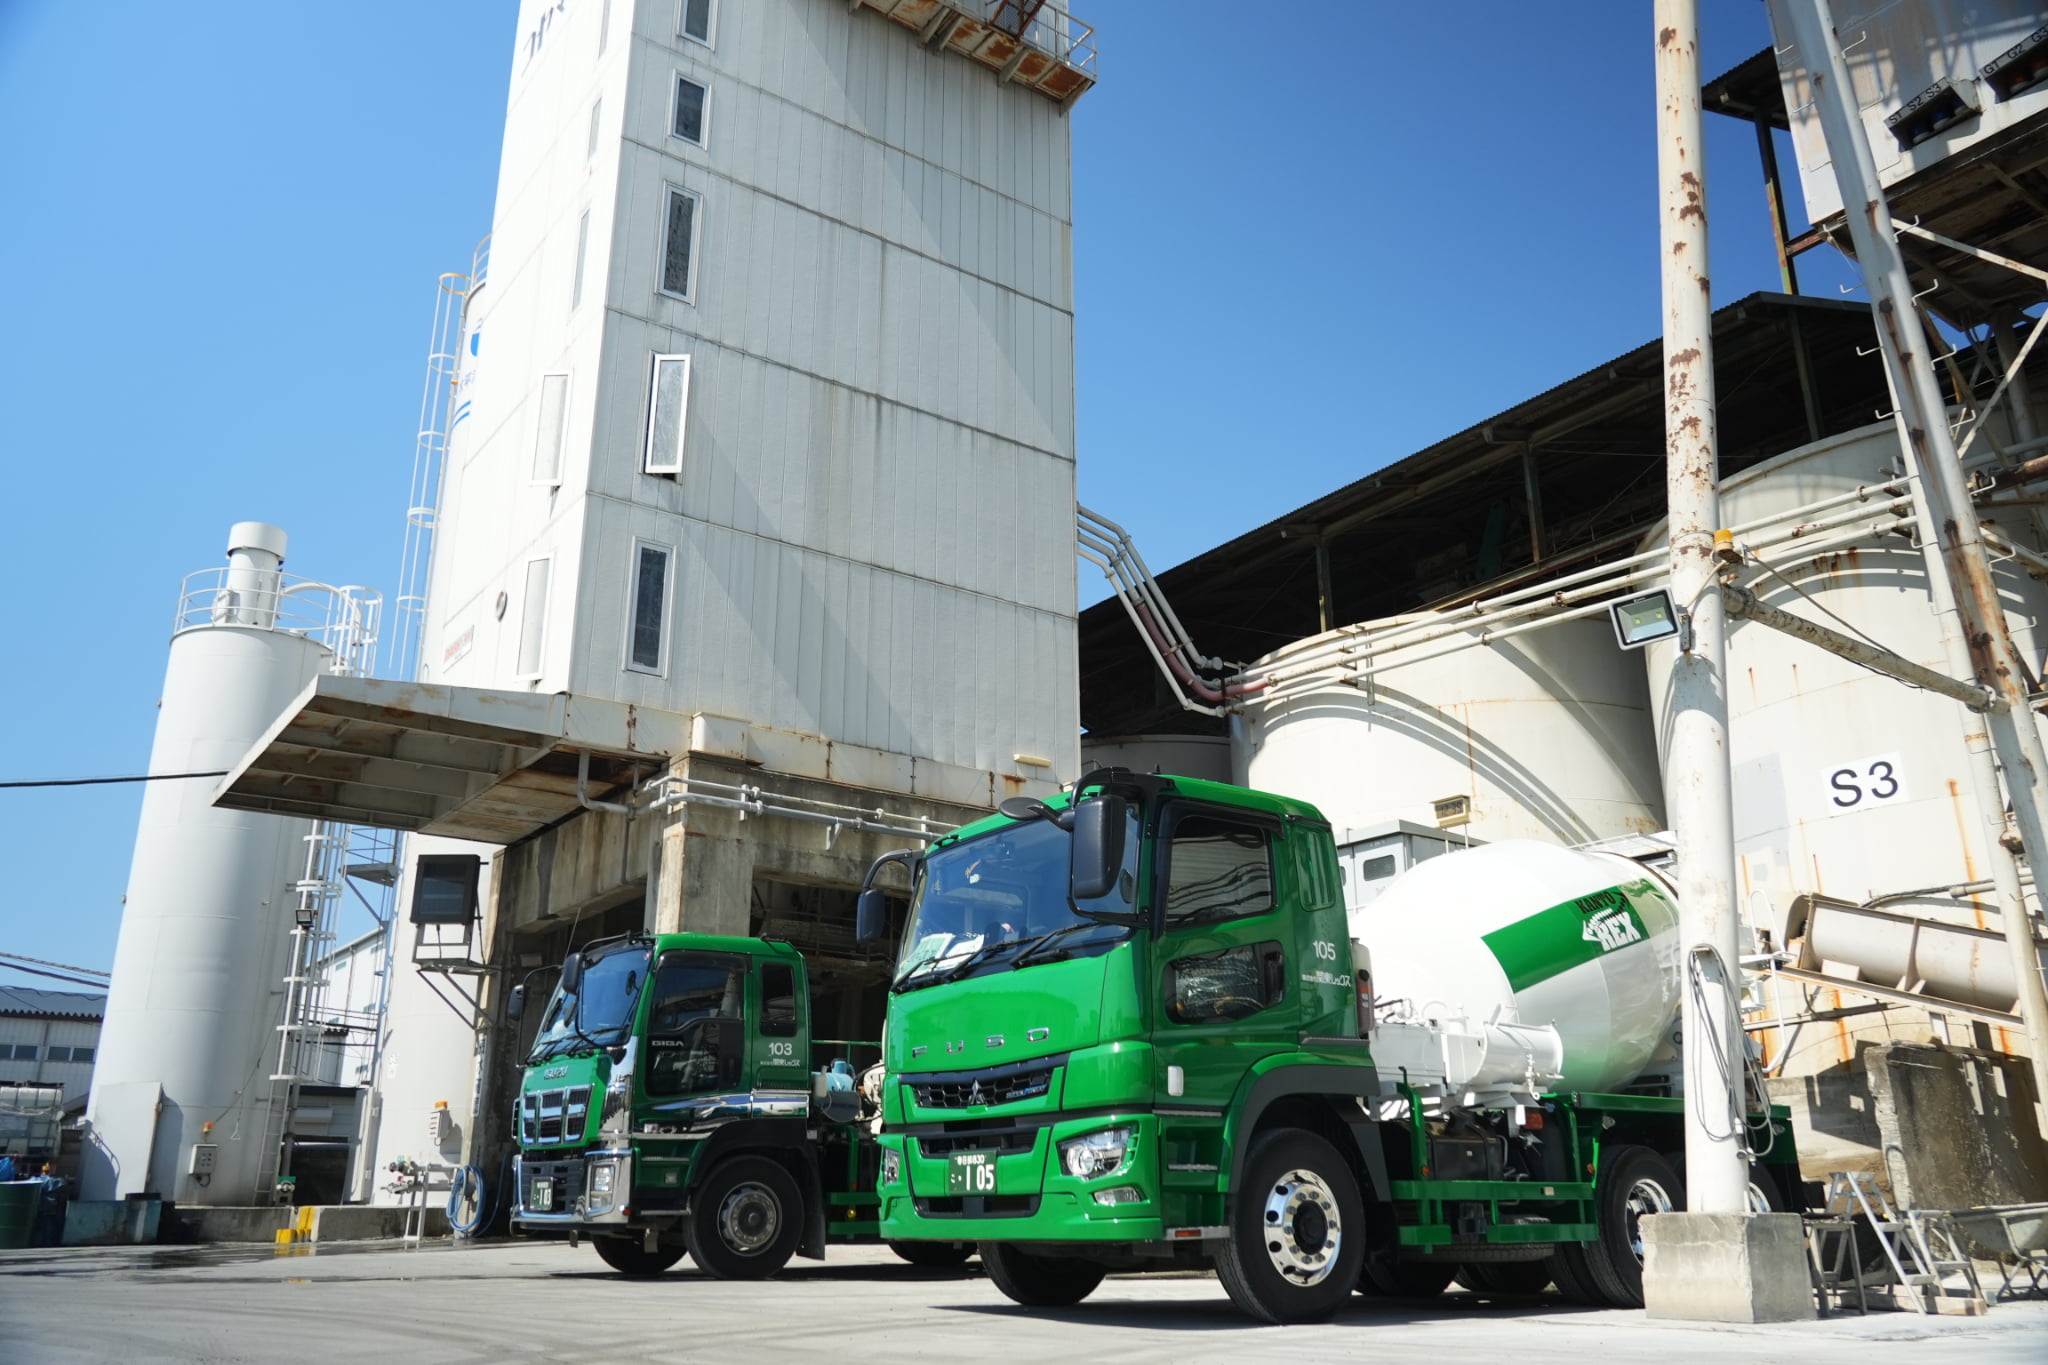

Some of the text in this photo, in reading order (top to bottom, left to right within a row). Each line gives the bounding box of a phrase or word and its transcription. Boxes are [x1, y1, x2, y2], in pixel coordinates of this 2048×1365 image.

[2007, 44, 2025, 59] G2
[1907, 96, 1924, 111] S2
[1925, 82, 1942, 98] S3
[1574, 890, 1617, 914] KANTO
[1597, 911, 1642, 952] REX
[1312, 940, 1336, 961] 105
[768, 1042, 793, 1056] 103
[911, 1027, 1049, 1059] FUSO
